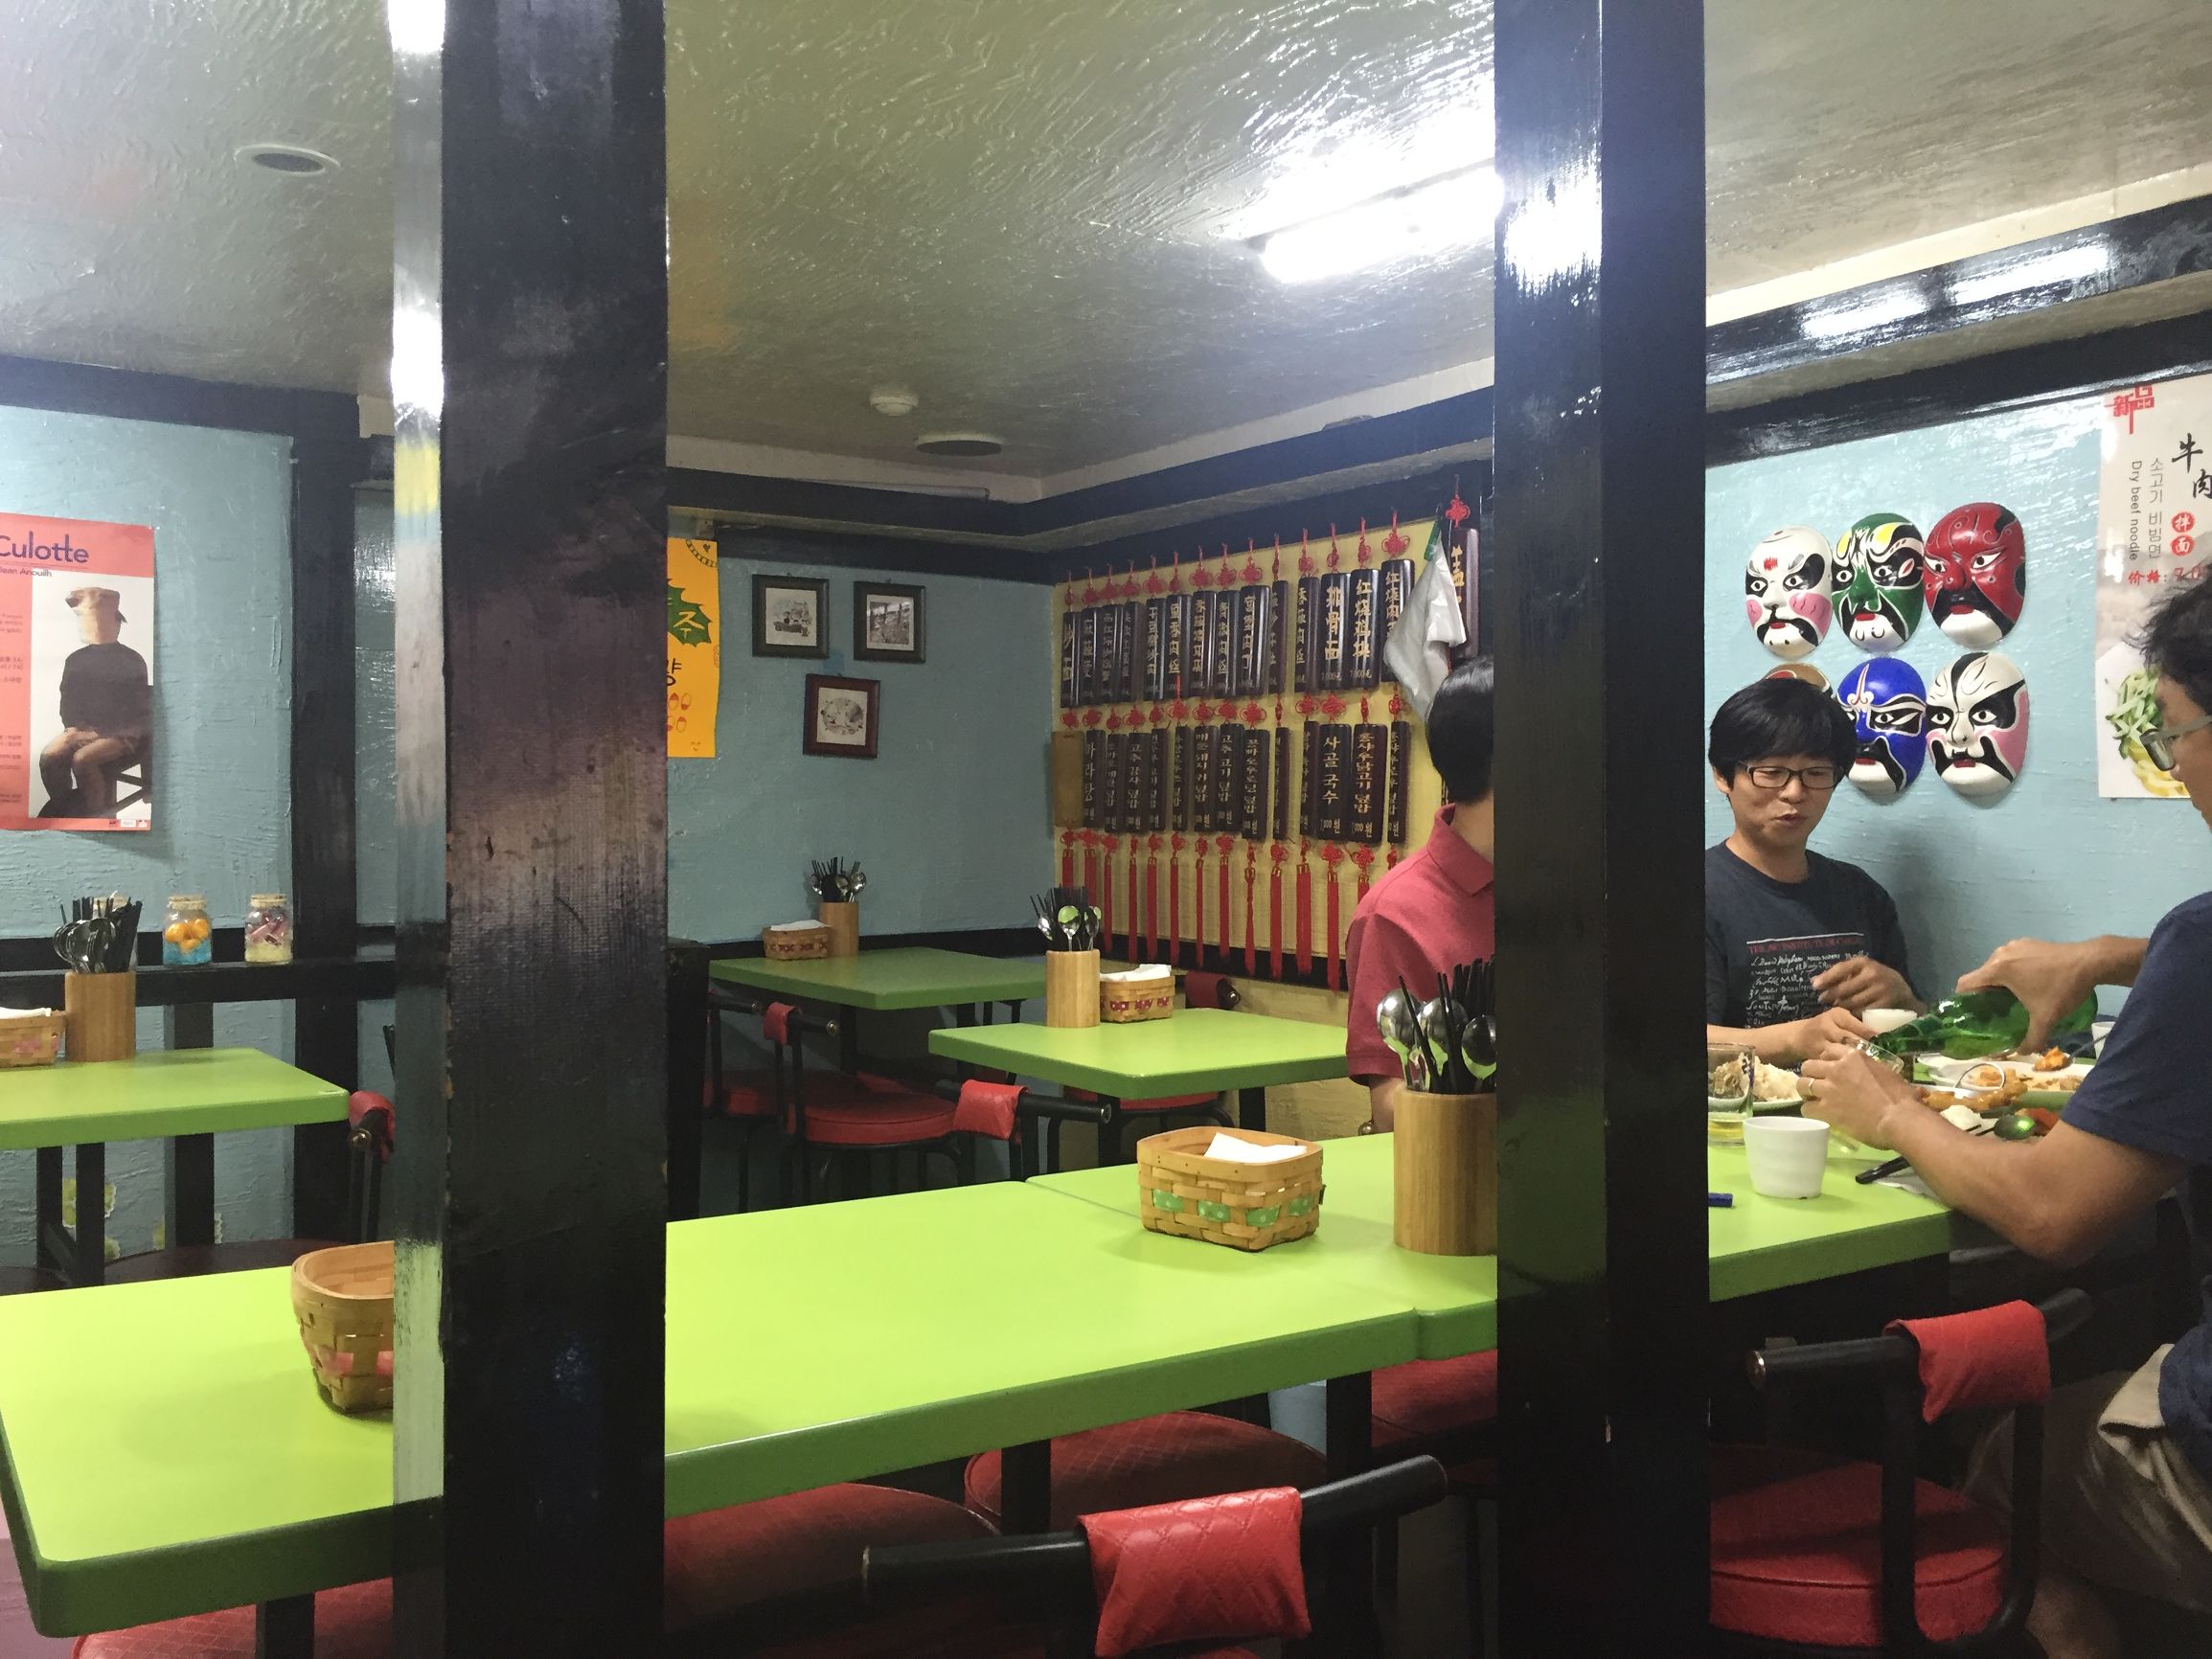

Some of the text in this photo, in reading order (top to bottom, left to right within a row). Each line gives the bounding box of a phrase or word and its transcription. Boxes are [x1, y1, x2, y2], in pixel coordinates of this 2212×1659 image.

[2129, 460, 2143, 561] Dry beef noodle
[2149, 458, 2164, 559] 소고기 비빔면
